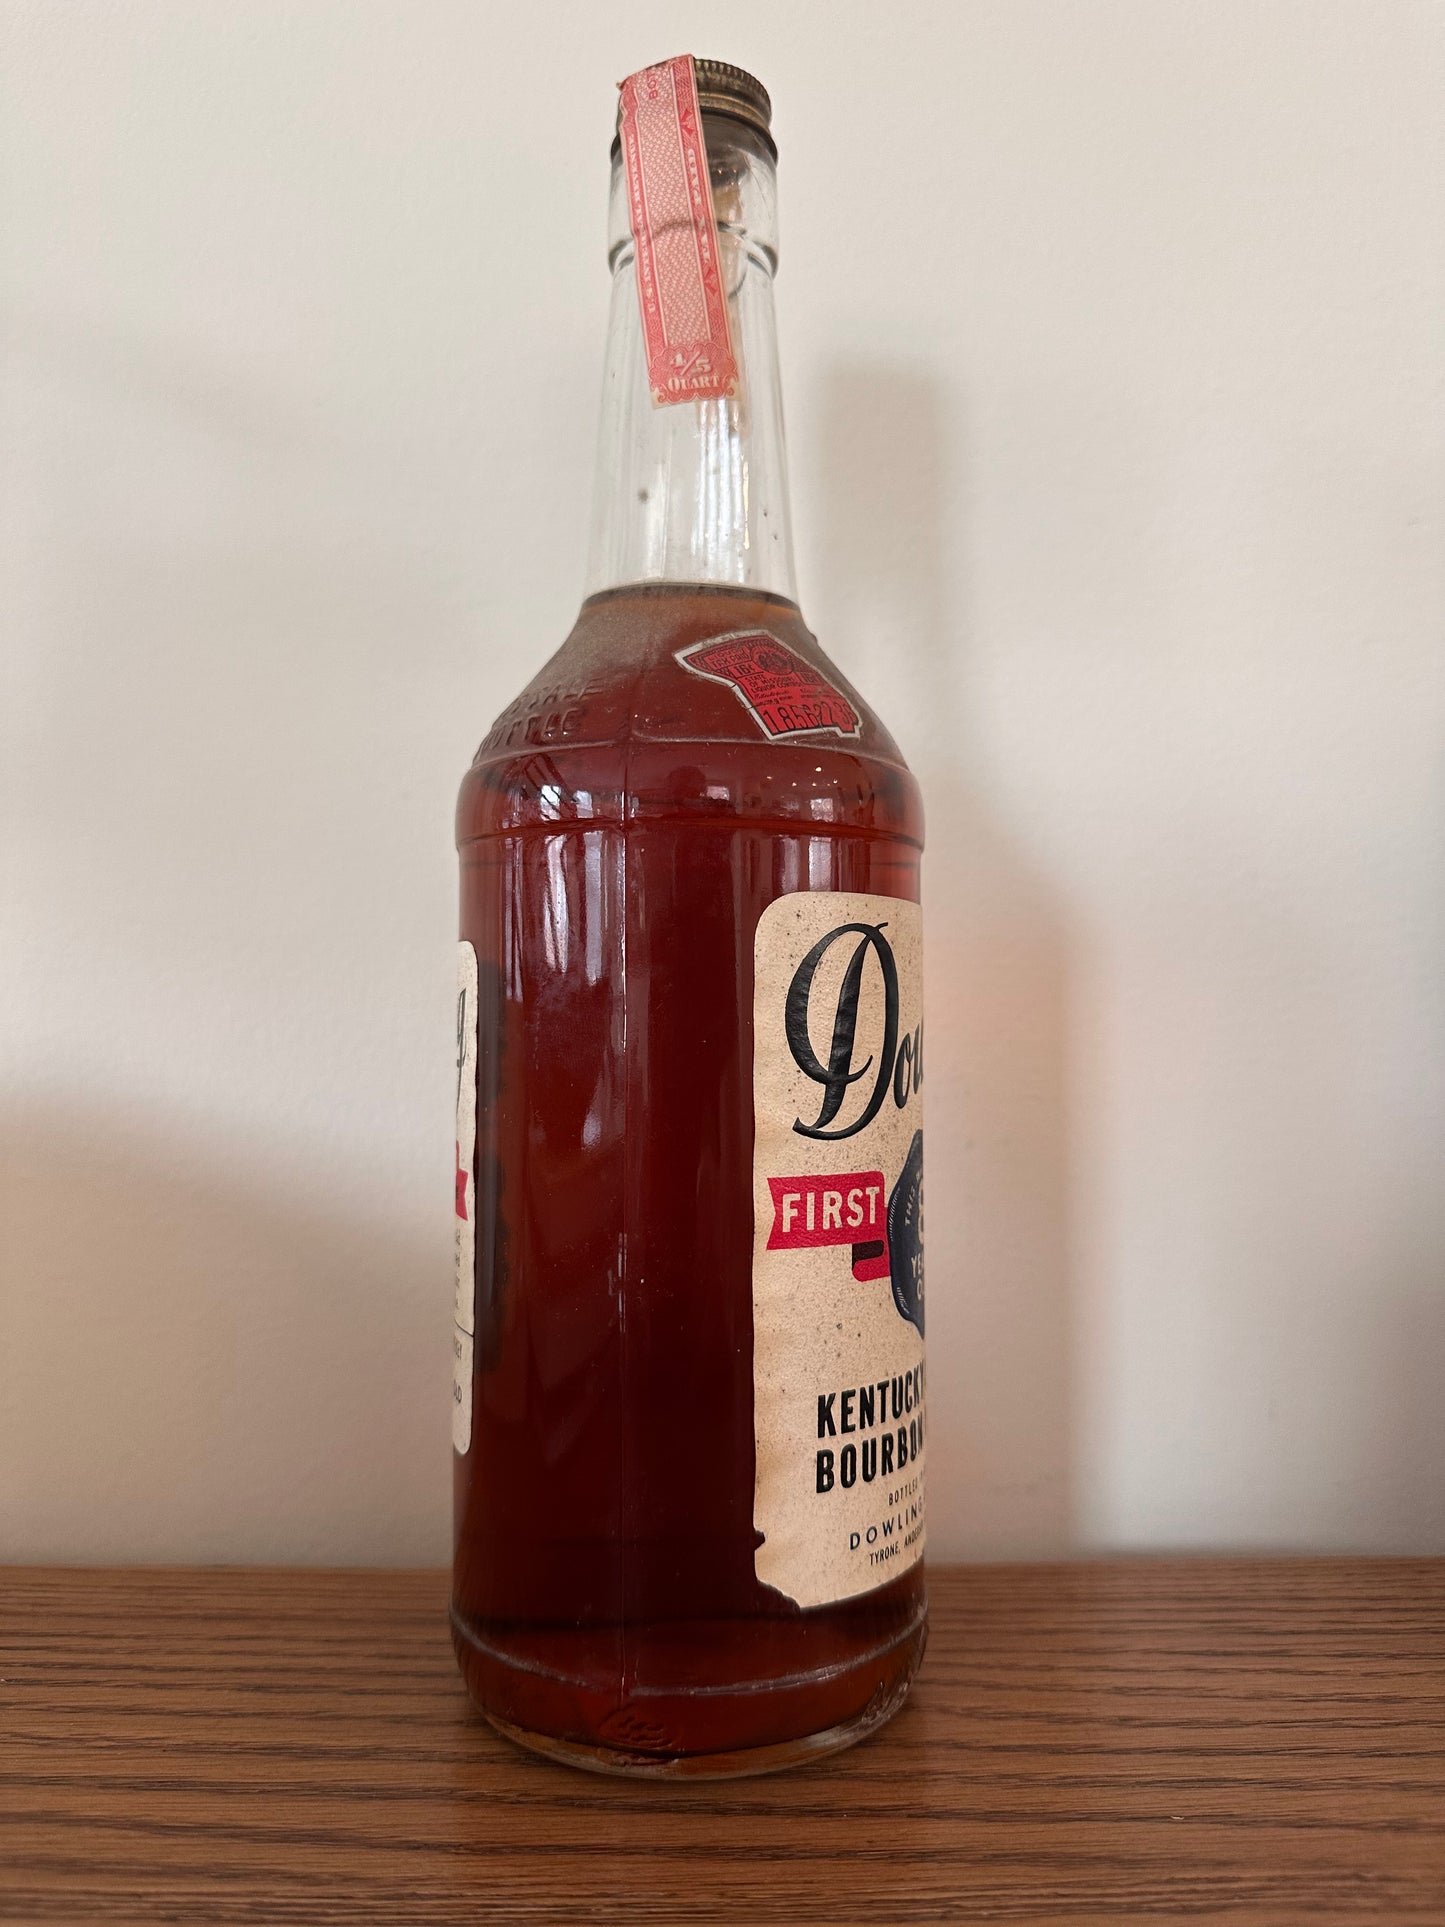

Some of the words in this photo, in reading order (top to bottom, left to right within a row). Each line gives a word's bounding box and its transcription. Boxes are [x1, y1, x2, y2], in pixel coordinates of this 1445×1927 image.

[628, 134, 640, 202] REVENUE
[687, 148, 702, 205] PAID
[697, 216, 711, 263] TAX
[782, 1186, 880, 1233] FIRST
[869, 1541, 901, 1566] TYRONE,
